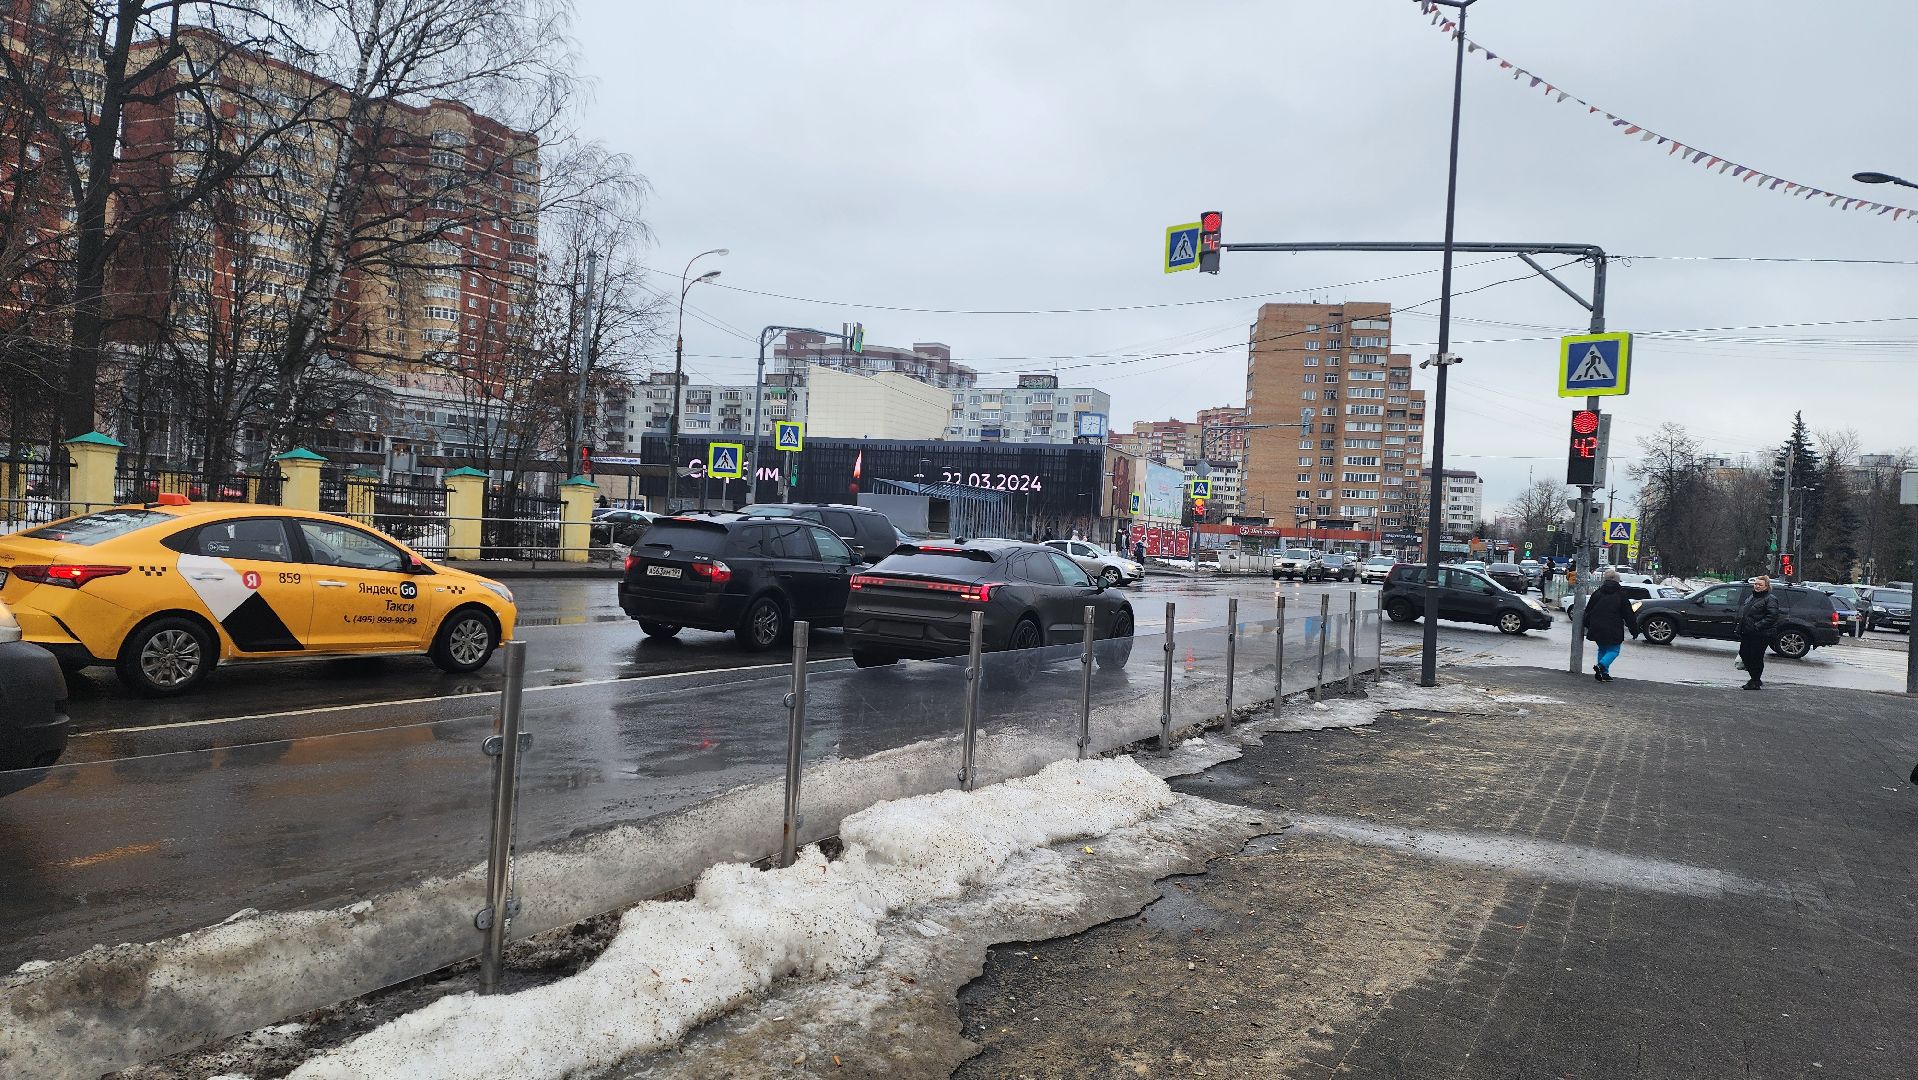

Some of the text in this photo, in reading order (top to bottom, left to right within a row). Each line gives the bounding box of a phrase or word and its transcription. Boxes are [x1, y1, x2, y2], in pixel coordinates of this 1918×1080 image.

[1204, 234, 1219, 250] 42
[1573, 437, 1597, 458] 42
[942, 472, 1041, 491] 2203.2024
[246, 574, 256, 586] Я
[279, 573, 301, 585] 859
[358, 583, 416, 596] Яндекс Go
[385, 600, 415, 611] Такси
[353, 615, 417, 625] (495) 999-99-99
